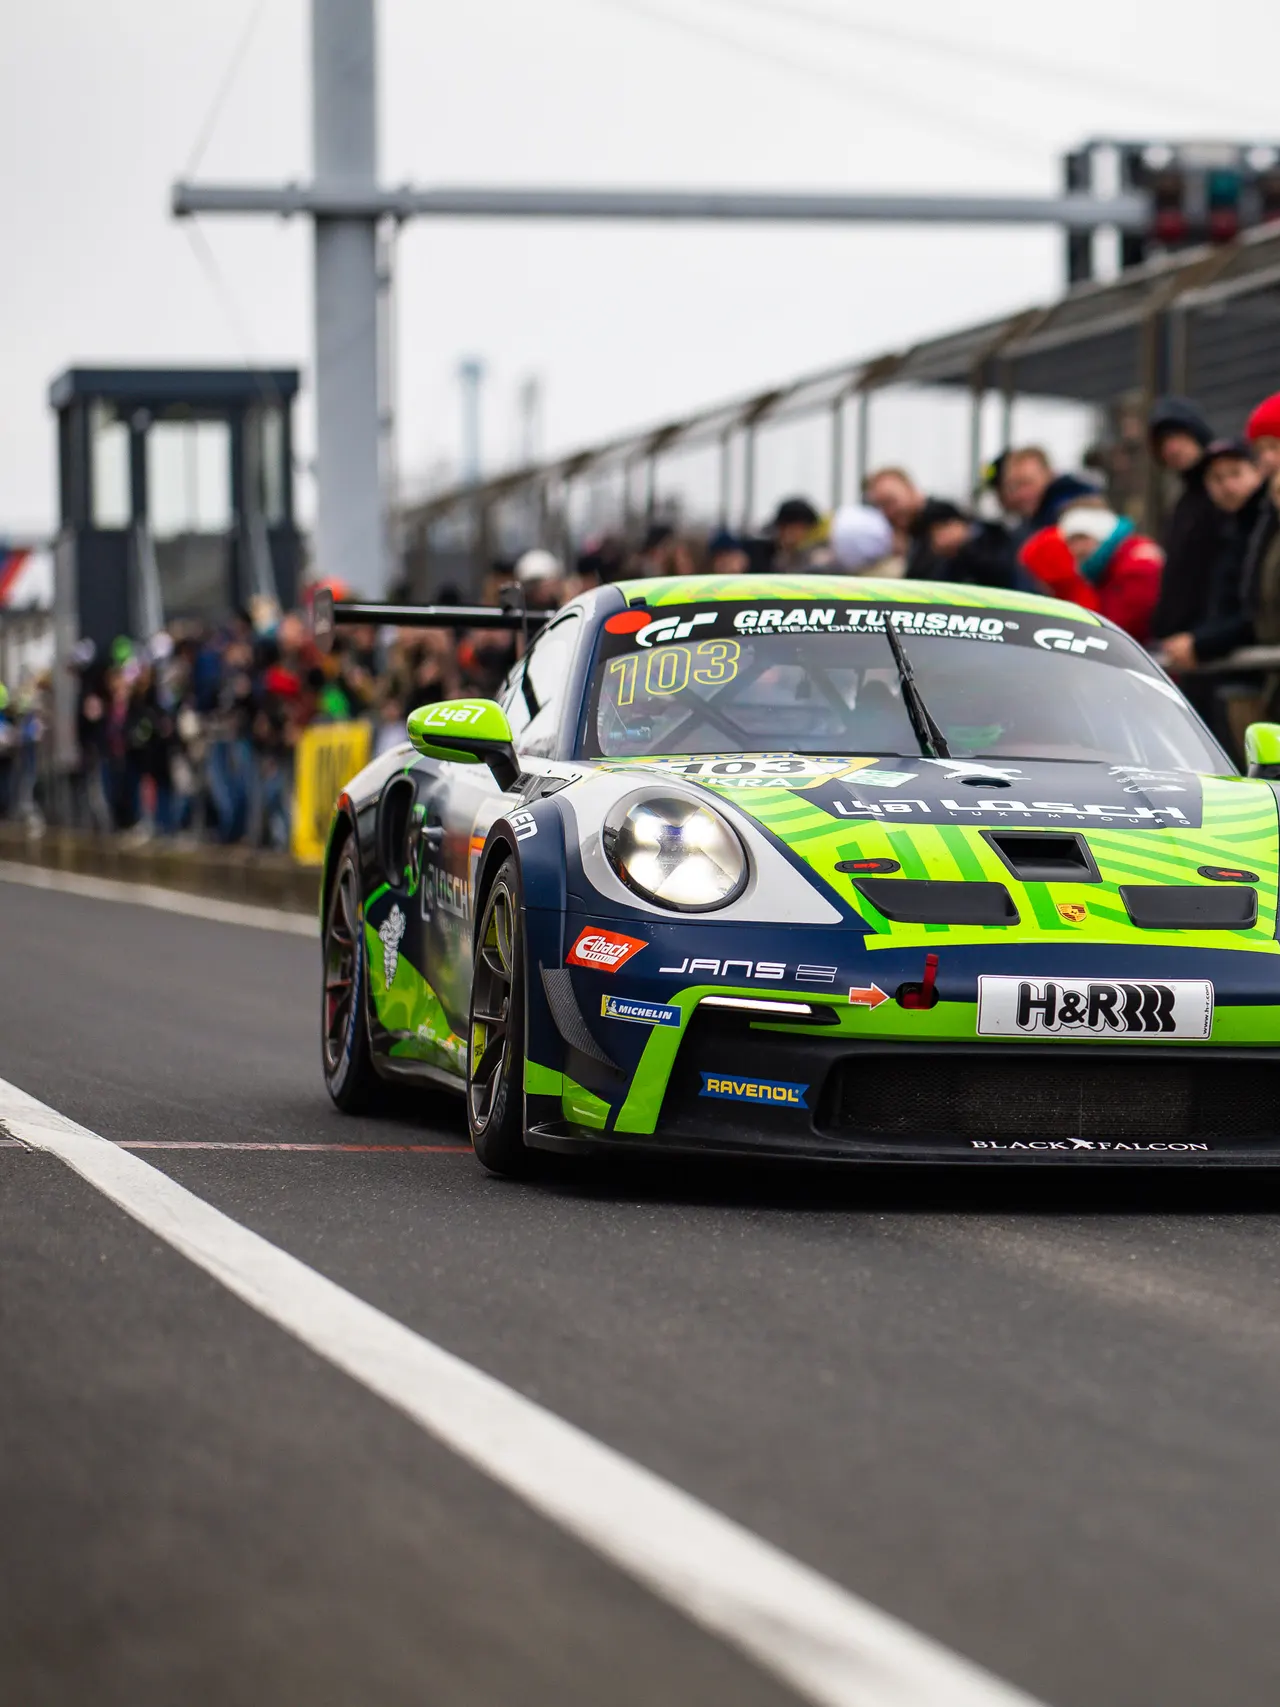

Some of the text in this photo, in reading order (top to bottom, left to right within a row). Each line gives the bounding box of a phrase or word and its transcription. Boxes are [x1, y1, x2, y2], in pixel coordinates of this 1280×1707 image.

[733, 608, 836, 628] GRAN
[736, 626, 772, 636] THE
[777, 625, 823, 633] REAL
[903, 626, 1004, 643] SIMULATOR
[610, 638, 741, 706] 103
[670, 760, 806, 775] 103
[949, 811, 1191, 825] LUXEMBOURG
[575, 935, 630, 964] Eibach
[618, 1004, 673, 1020] MICHELIN
[1202, 984, 1211, 1036] www.h-r.com
[707, 1078, 799, 1103] RAVENOL
[970, 1140, 1209, 1151] BLACK FALCON
